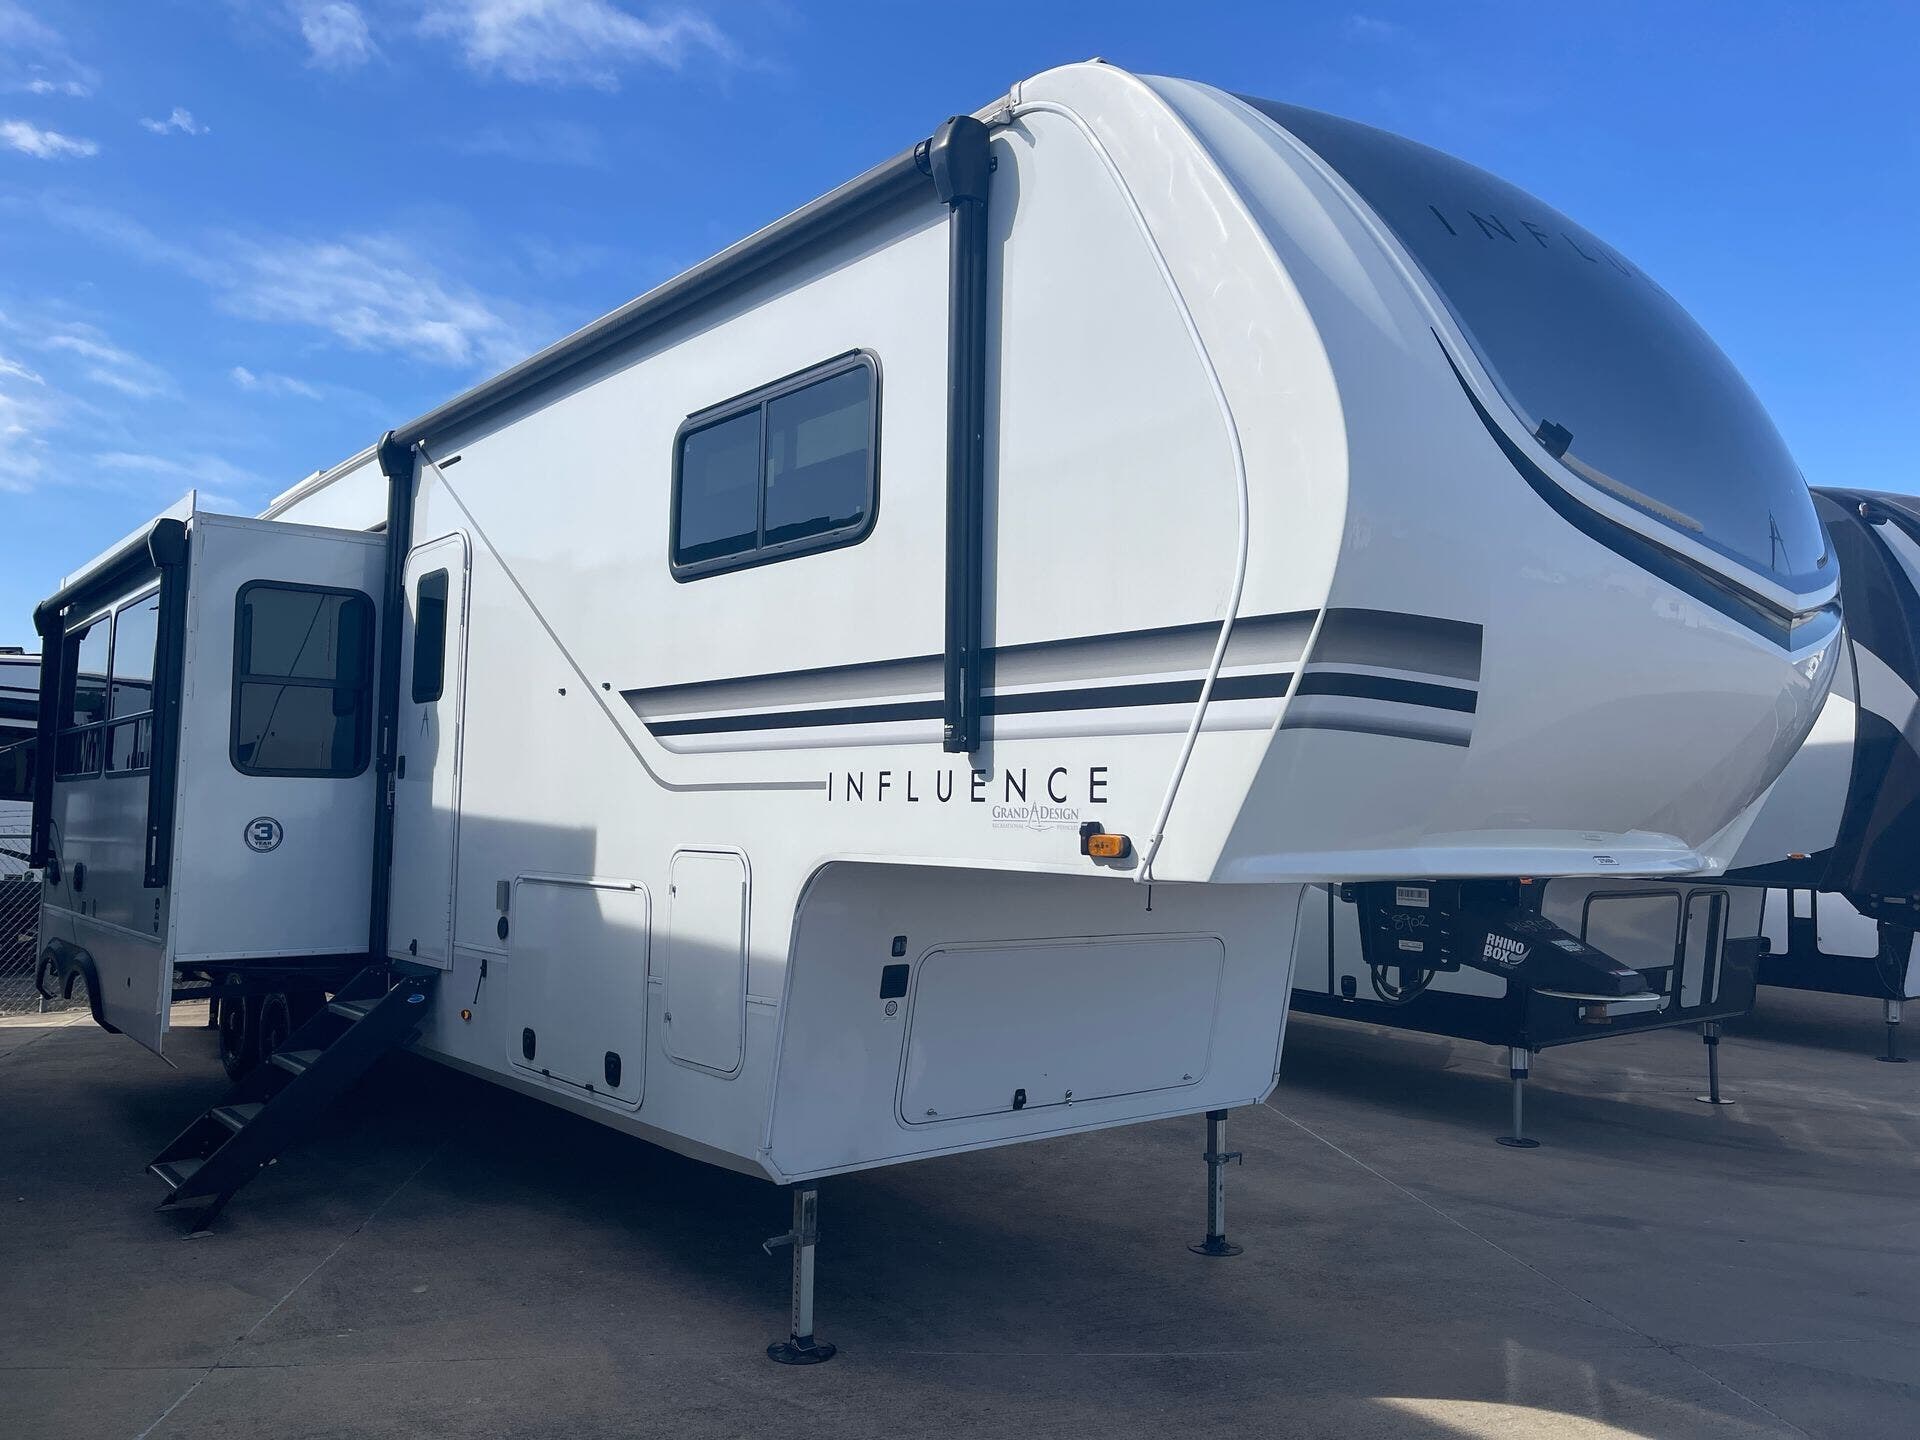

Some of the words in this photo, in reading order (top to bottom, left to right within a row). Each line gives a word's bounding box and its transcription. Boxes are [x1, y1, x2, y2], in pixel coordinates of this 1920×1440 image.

[828, 766, 1108, 803] INFLUENCE
[992, 805, 1029, 819] GRAND
[1040, 805, 1079, 820] DESIGN
[254, 823, 273, 840] 3
[1486, 932, 1525, 954] RHINO
[1483, 944, 1510, 963] BOX
